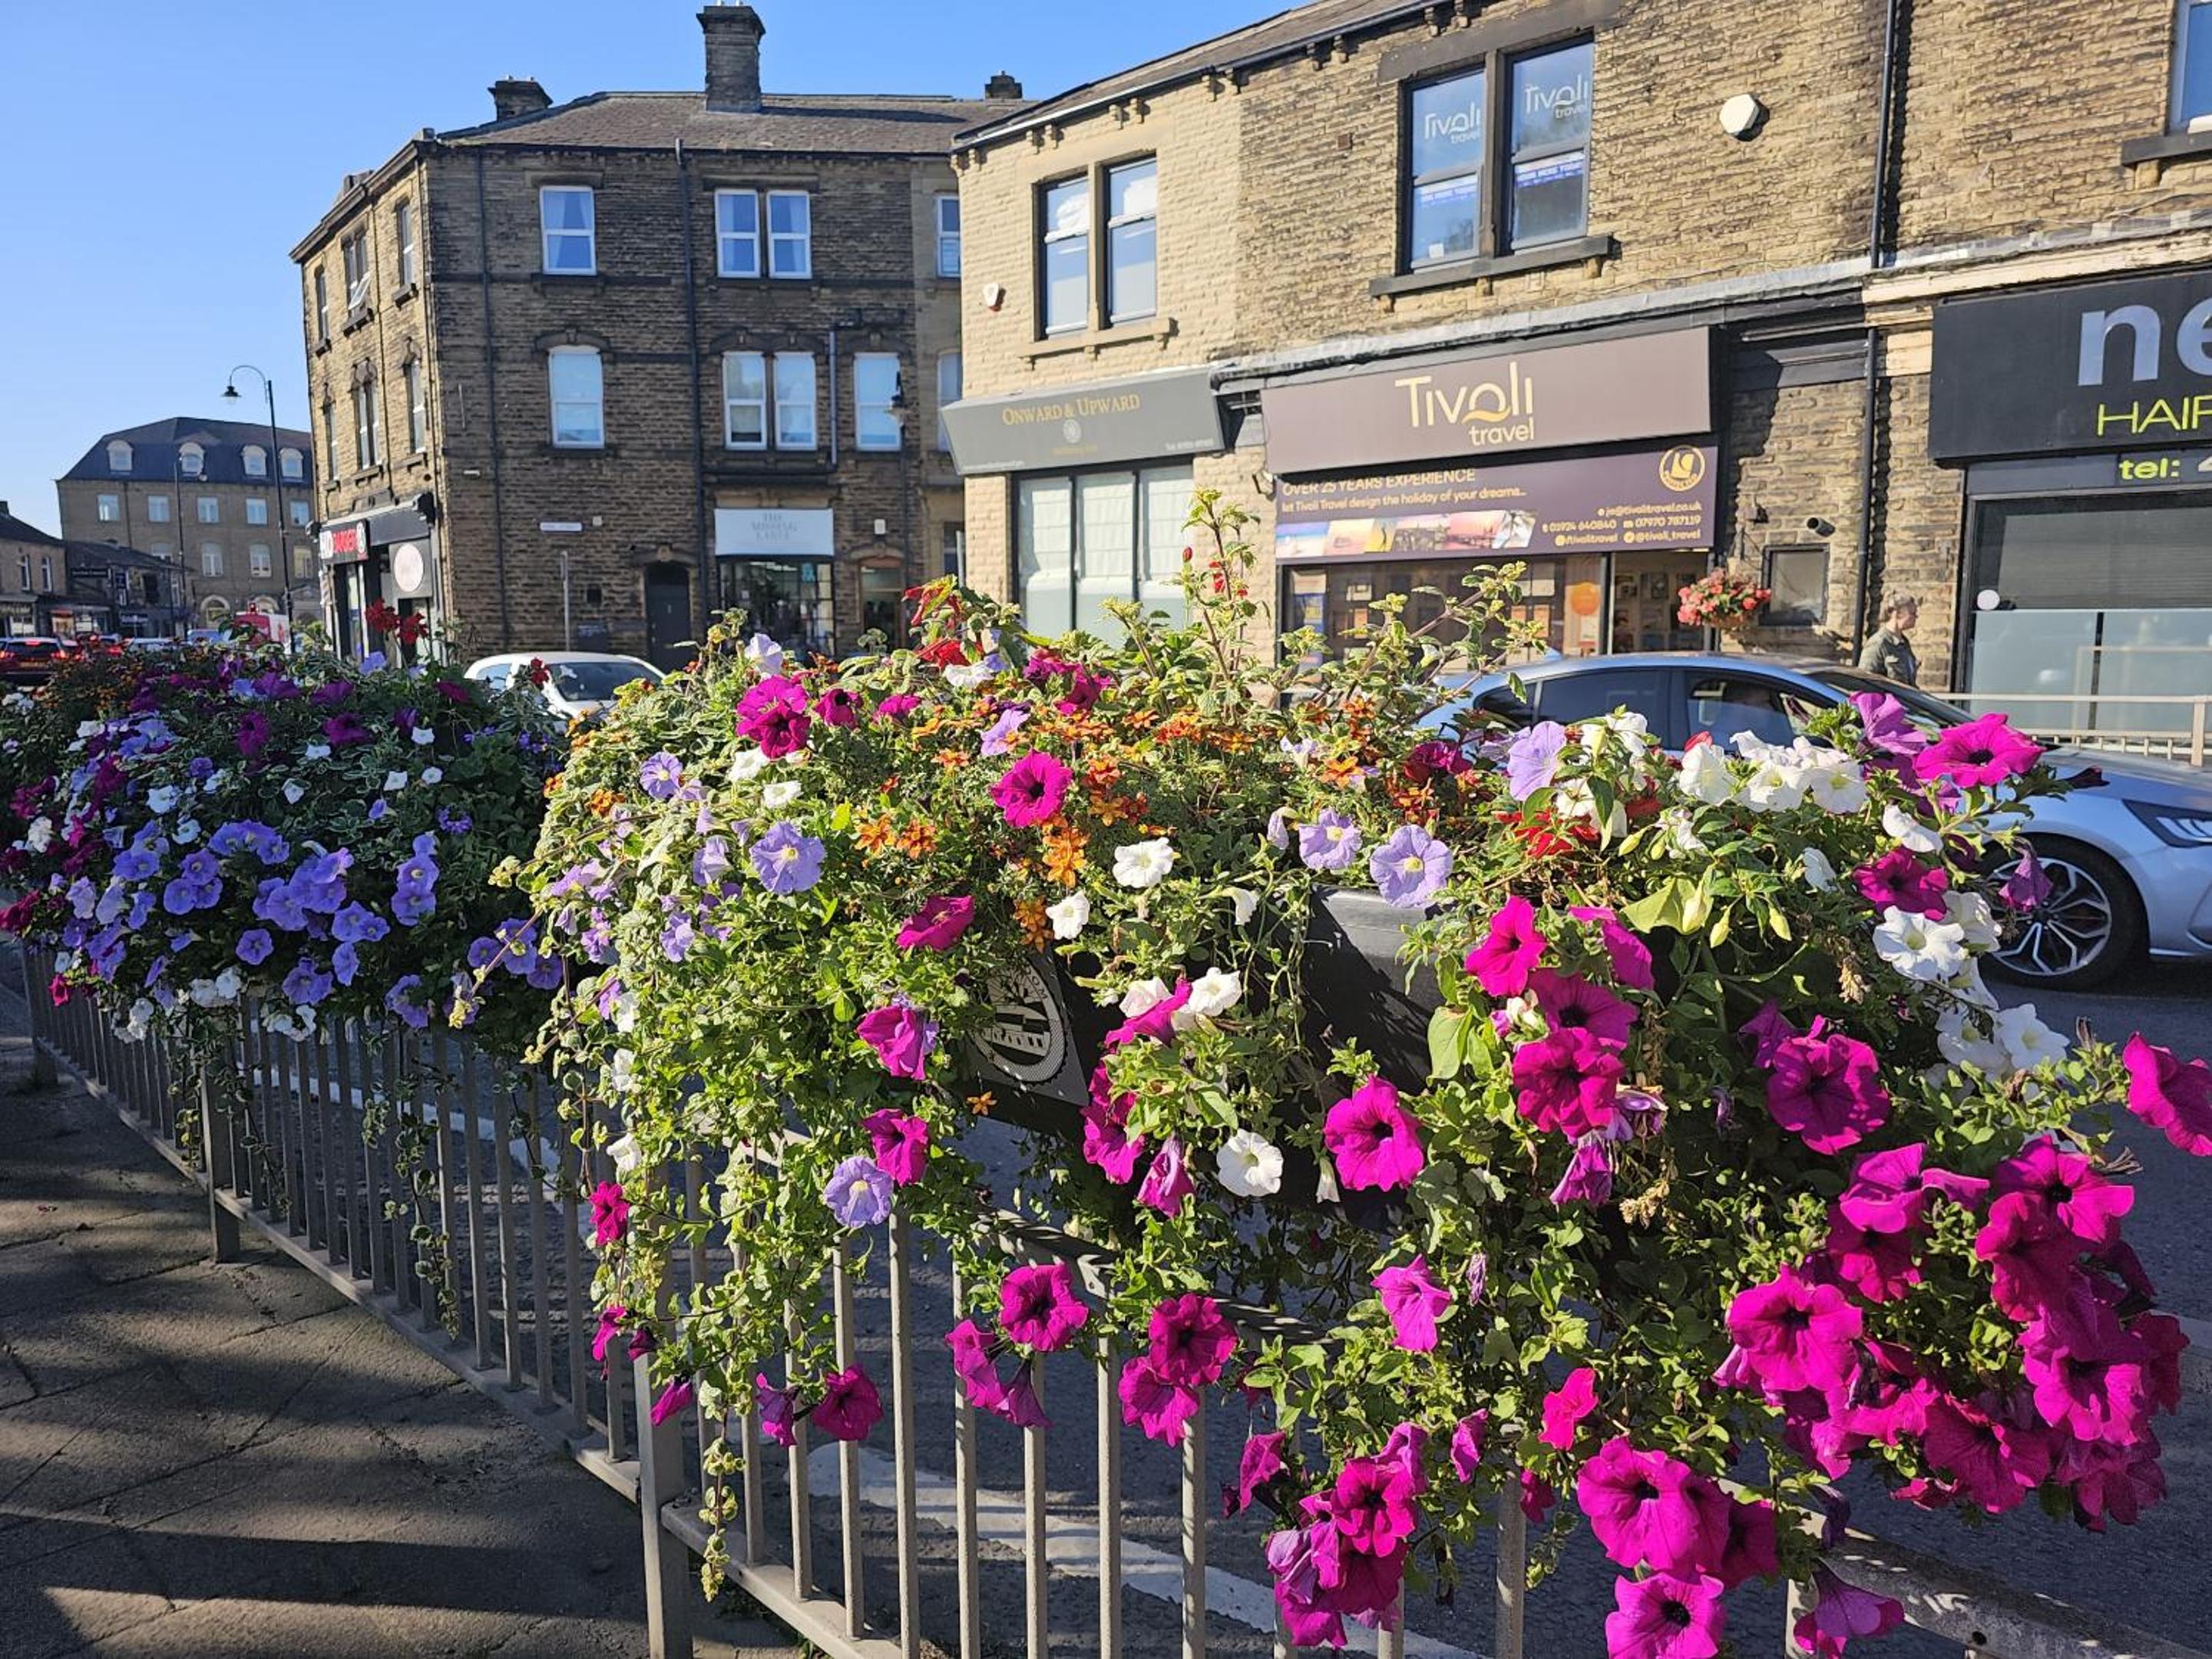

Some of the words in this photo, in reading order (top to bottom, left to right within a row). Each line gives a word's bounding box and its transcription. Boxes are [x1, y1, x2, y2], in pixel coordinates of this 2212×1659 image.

[1525, 74, 1588, 114] Tivoli
[1425, 102, 1480, 139] Tivoli
[1394, 361, 1533, 428] Tivoli
[1063, 403, 1074, 418] &
[1469, 417, 1535, 446] travel
[1282, 482, 1319, 496] OVER
[1339, 477, 1383, 492] YEARS
[1386, 468, 1476, 488] EXPERIENCE
[2119, 458, 2181, 480] tel:
[1296, 501, 1319, 511] Tivoli
[1321, 499, 1347, 510] Travel
[1349, 496, 1380, 510] design
[1383, 494, 1400, 505] the
[1400, 492, 1438, 504] holiday
[1440, 489, 1452, 501] of
[1453, 490, 1477, 504] your
